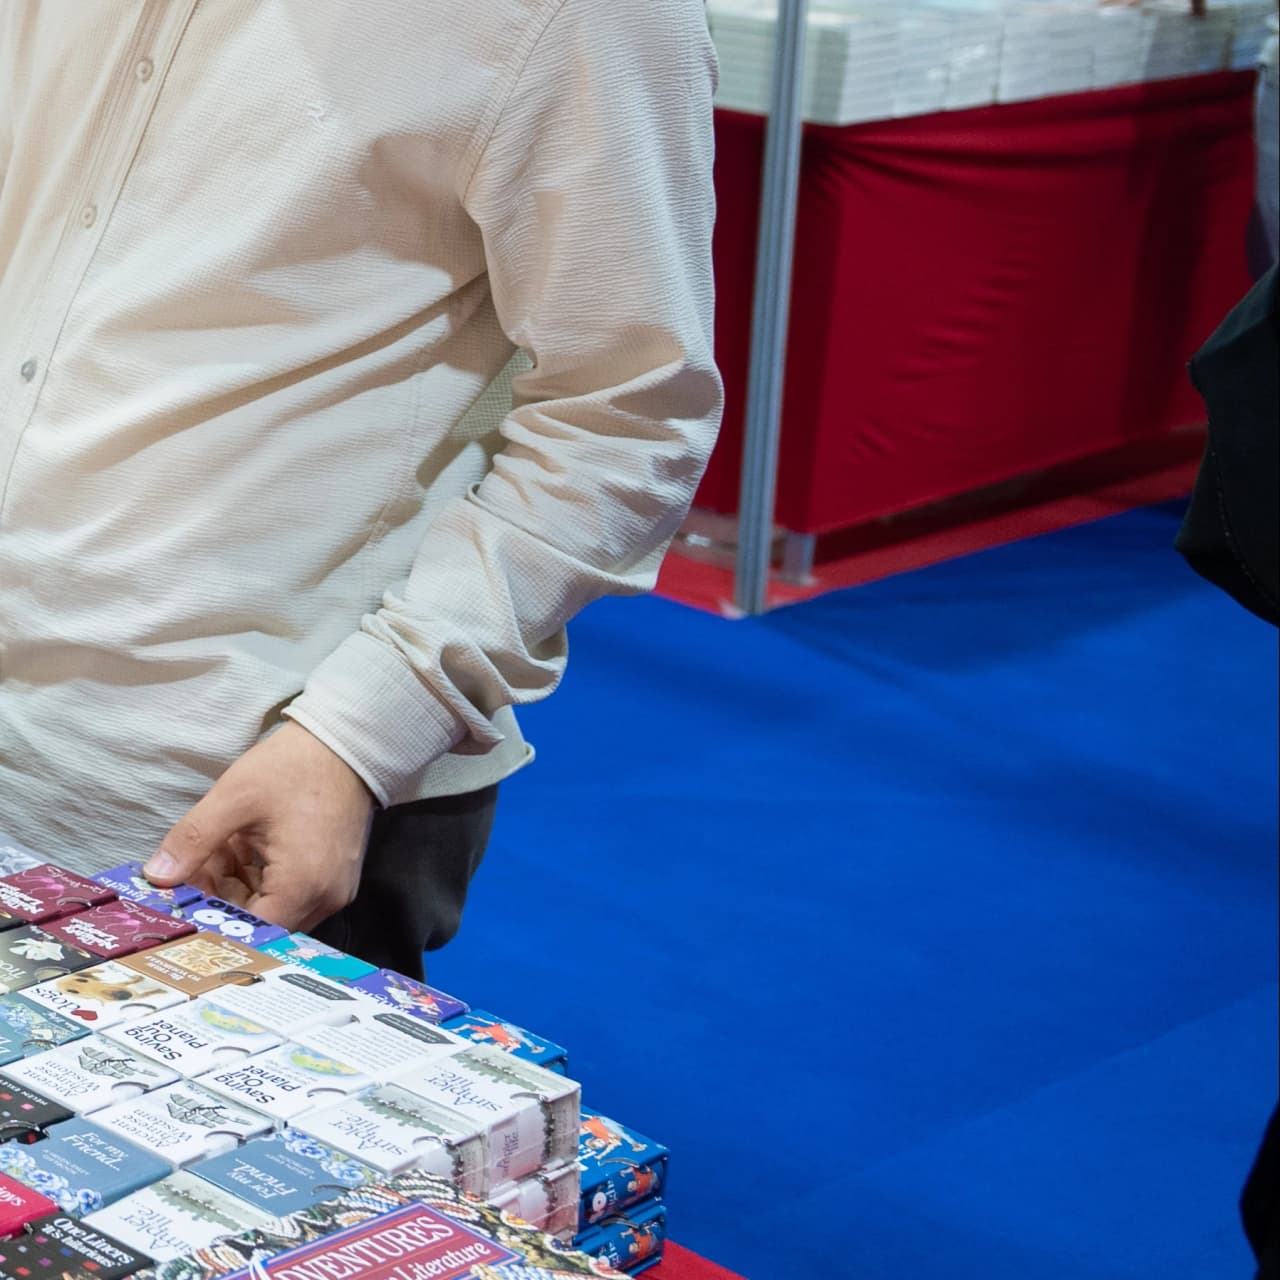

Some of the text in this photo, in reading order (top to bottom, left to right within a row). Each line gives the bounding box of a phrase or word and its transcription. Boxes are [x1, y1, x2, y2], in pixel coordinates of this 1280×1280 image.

[207, 898, 274, 928] over
[30, 986, 81, 1013] dogs
[123, 1027, 183, 1063] Saving
[137, 1025, 172, 1042] Our
[157, 1018, 209, 1050] Planet
[21, 1068, 79, 1099] Ancient
[213, 1073, 276, 1105] Saving
[232, 1071, 265, 1089] Our
[241, 1064, 301, 1094] Planet
[424, 1076, 506, 1113] simpler
[83, 1131, 110, 1146] For
[328, 1120, 408, 1158] simpler
[225, 1170, 278, 1200] For my
[52, 1217, 135, 1264] One Liners
[400, 1240, 492, 1280] Literature
